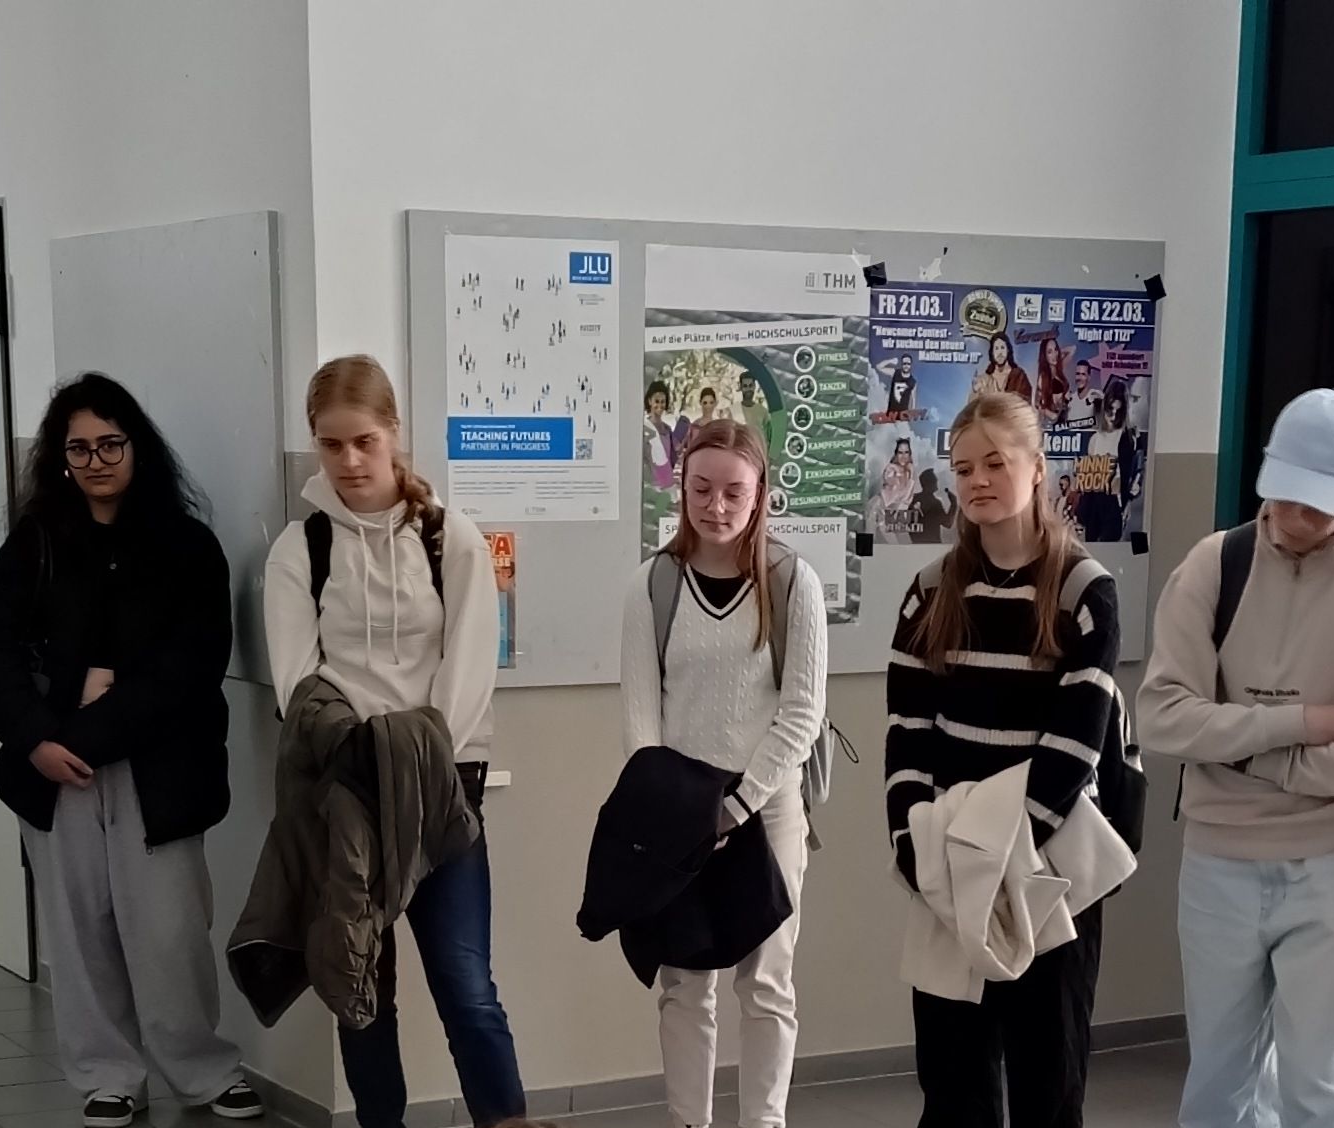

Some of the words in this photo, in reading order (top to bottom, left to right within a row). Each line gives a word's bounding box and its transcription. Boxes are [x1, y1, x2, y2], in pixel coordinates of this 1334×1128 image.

[578, 256, 610, 275] JLU
[823, 273, 856, 289] THM
[878, 294, 897, 315] FR
[898, 294, 944, 317] 21.03.
[1080, 300, 1100, 321] SA
[1101, 301, 1146, 323] 22.03.
[651, 334, 667, 344] Auf
[668, 333, 681, 344] die
[683, 331, 714, 344] Plätze,
[1103, 329, 1114, 341] of
[882, 338, 895, 348] wir
[895, 339, 924, 349] suchen
[925, 340, 940, 350] den
[818, 352, 849, 363] FITNESS
[918, 351, 952, 362] Mallorca
[953, 352, 969, 362] Star
[818, 381, 848, 392] TANZEN
[815, 408, 857, 421] BALLSPORT
[460, 431, 508, 441] TEACHING
[510, 431, 551, 441] FUTURES
[460, 442, 499, 451] PARTNERS
[500, 442, 510, 451] IN
[511, 442, 551, 452] PROGRESS
[808, 439, 857, 450] KAMPFSPORT
[1044, 433, 1081, 453] kend
[1074, 454, 1116, 473] MINNIE
[805, 467, 857, 480] EXKURSIONEN
[1075, 472, 1112, 492] ROCK
[788, 491, 863, 506] GESUNDHEITSKURSE
[767, 523, 842, 534] CHSCHULSPORT
